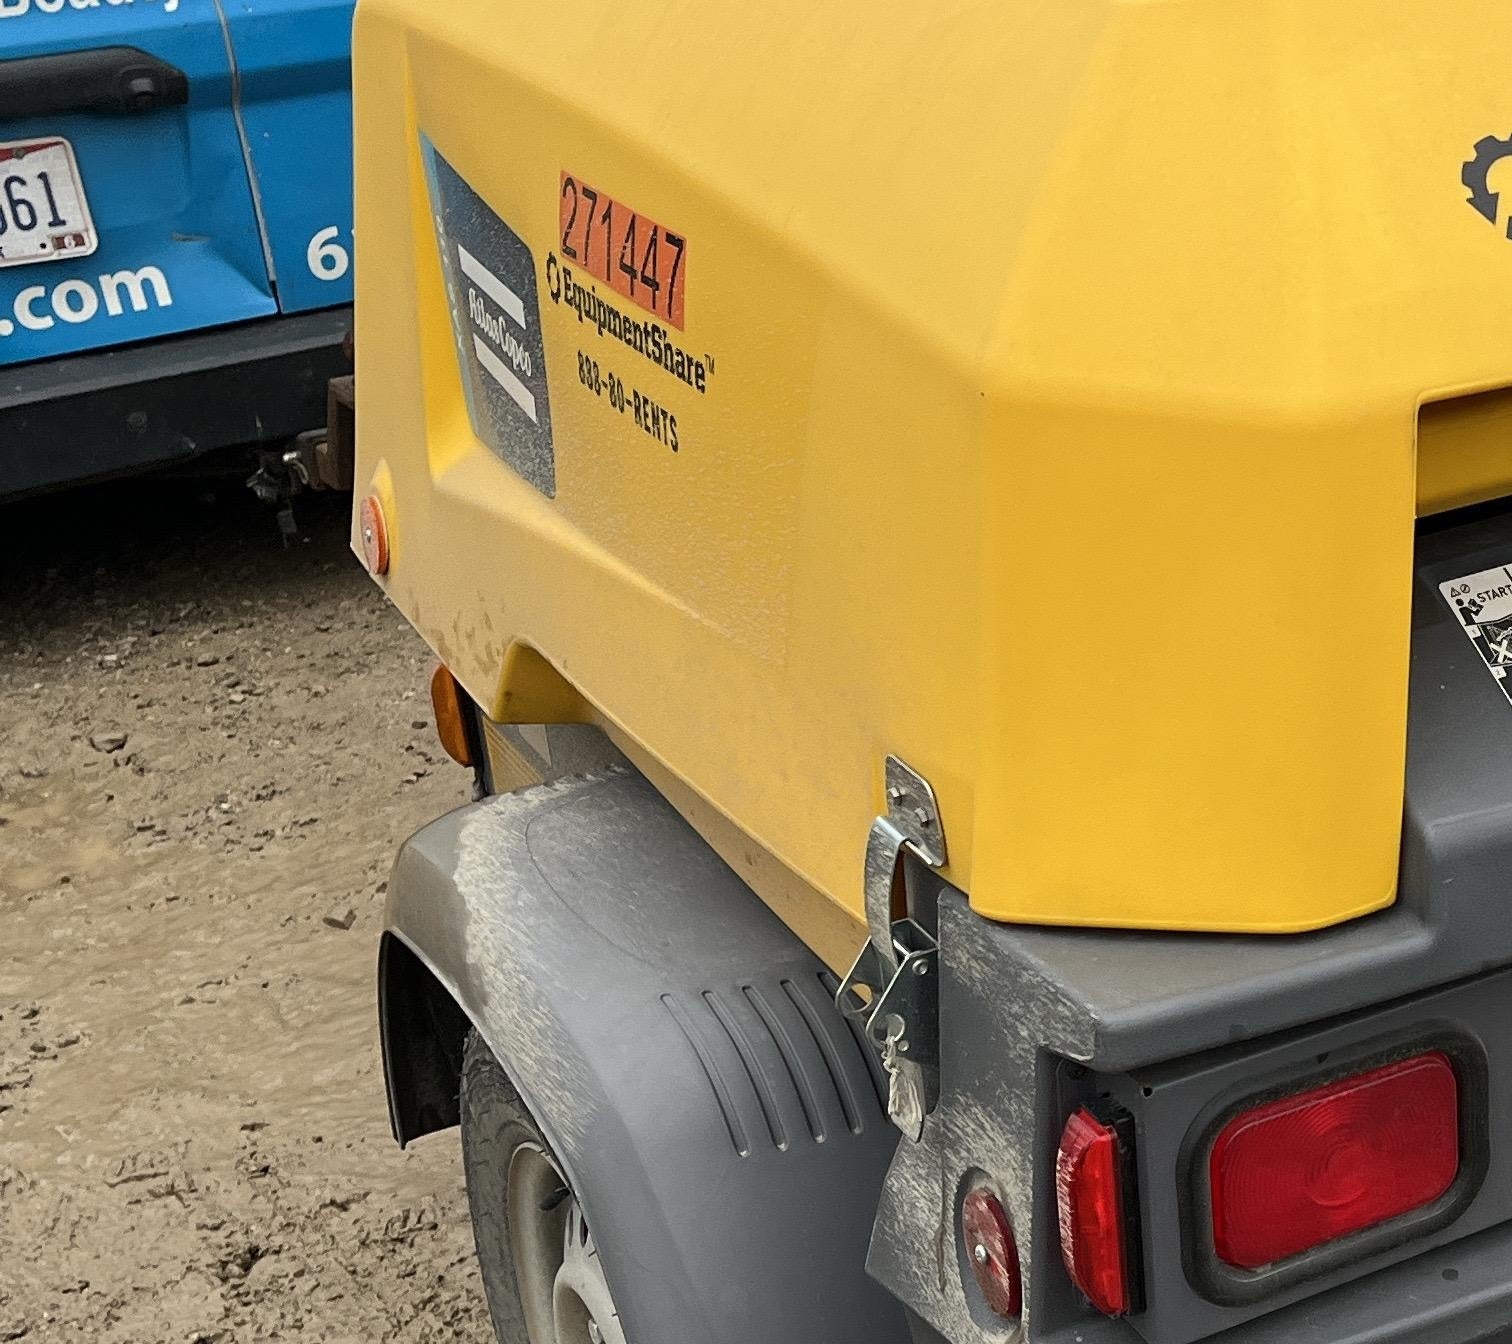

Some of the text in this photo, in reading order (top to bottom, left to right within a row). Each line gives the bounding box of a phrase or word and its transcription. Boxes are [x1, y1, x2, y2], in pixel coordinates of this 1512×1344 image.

[307, 225, 355, 282] 6
[562, 175, 686, 321] 271447
[577, 350, 679, 454] 888-80-RENTS
